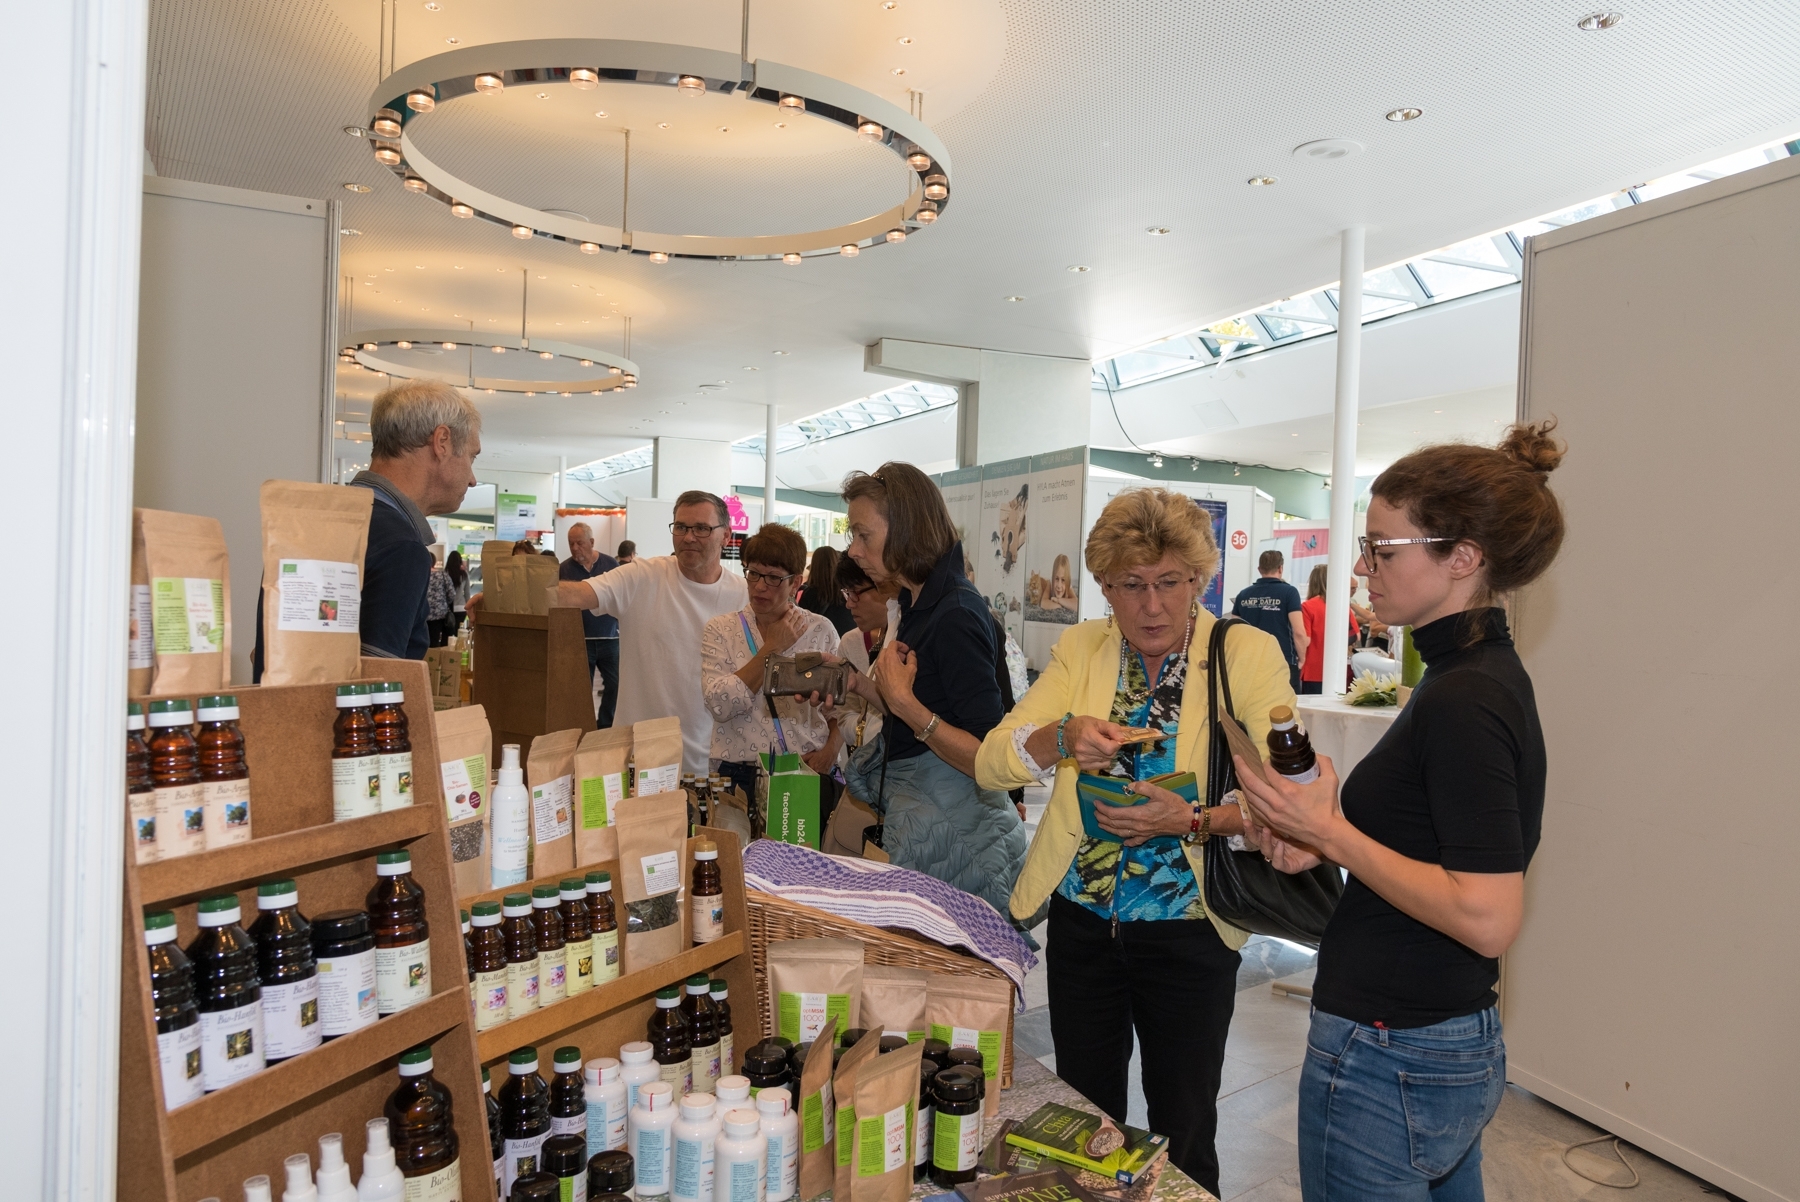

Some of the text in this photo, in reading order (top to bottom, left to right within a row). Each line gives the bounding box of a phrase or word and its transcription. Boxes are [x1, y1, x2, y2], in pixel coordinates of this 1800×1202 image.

[1232, 534, 1246, 546] 36
[1015, 1151, 1042, 1171] HA
[984, 1186, 1035, 1202] SUPER FOOD
